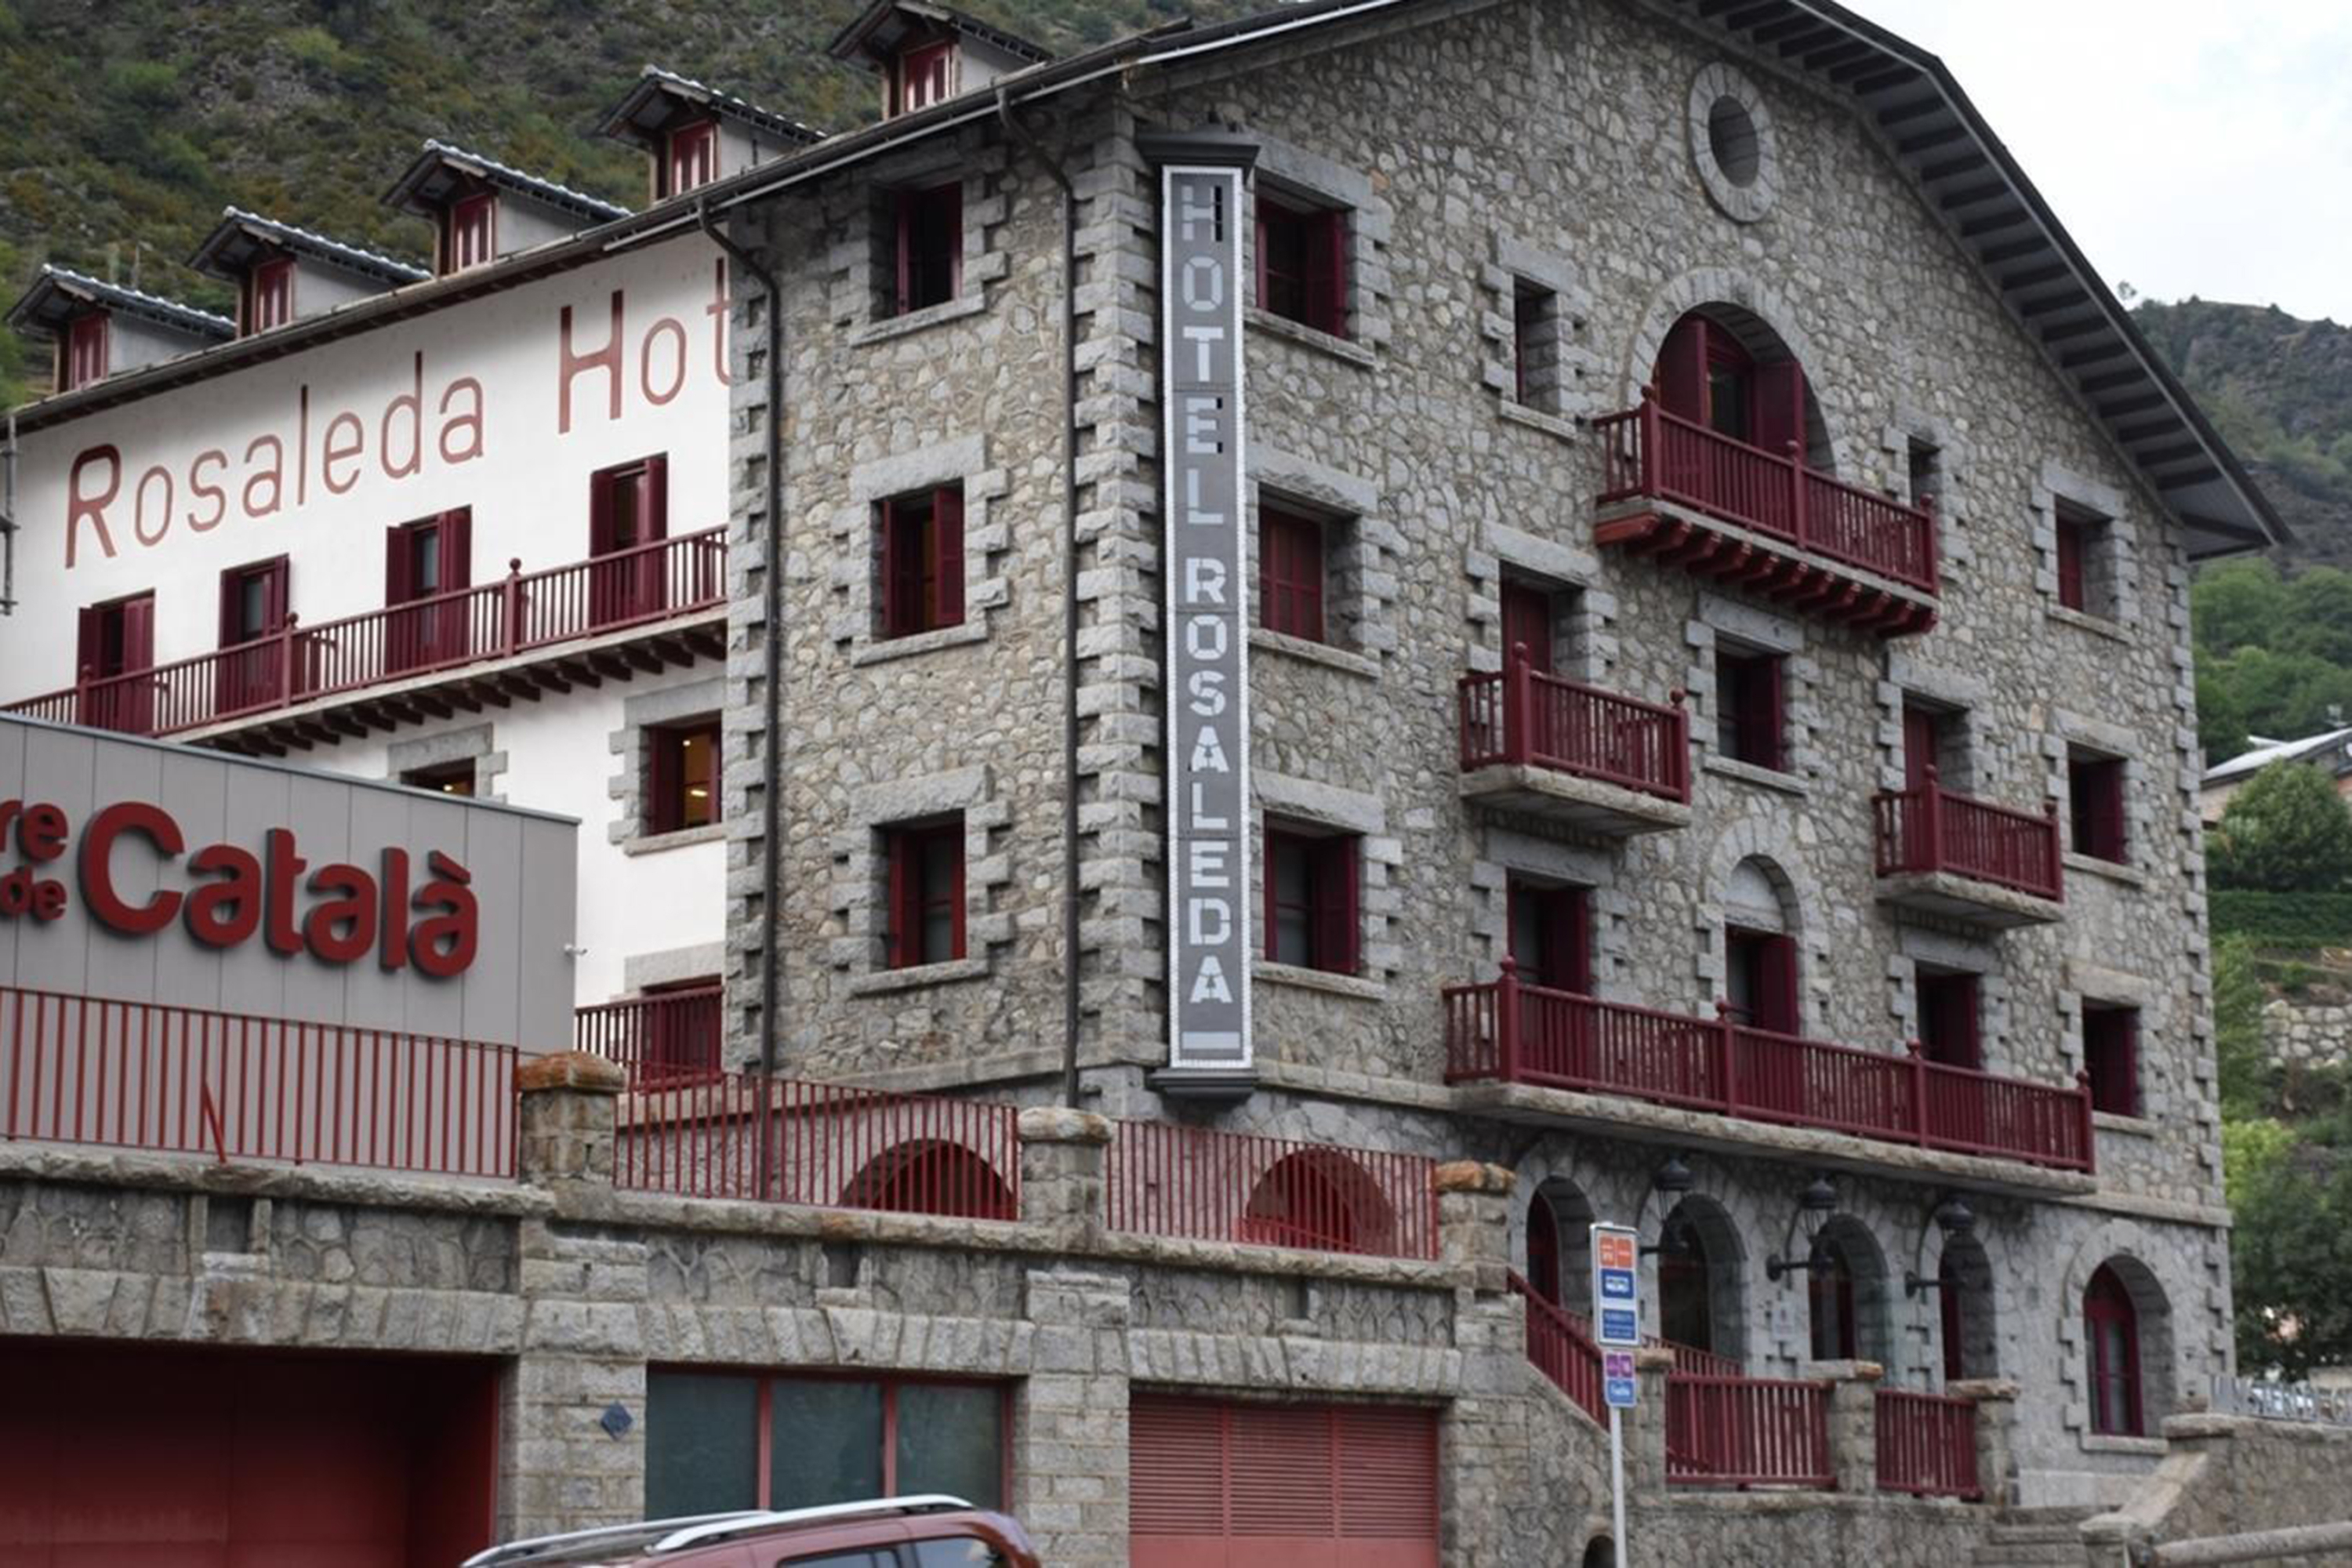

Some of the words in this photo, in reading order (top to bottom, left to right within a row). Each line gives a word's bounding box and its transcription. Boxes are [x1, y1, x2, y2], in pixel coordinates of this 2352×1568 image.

[65, 350, 485, 569] Rosaleda
[1181, 184, 1225, 525] HOTEL
[82, 800, 478, 978] Català
[1185, 556, 1233, 1004] ROSALEDA
